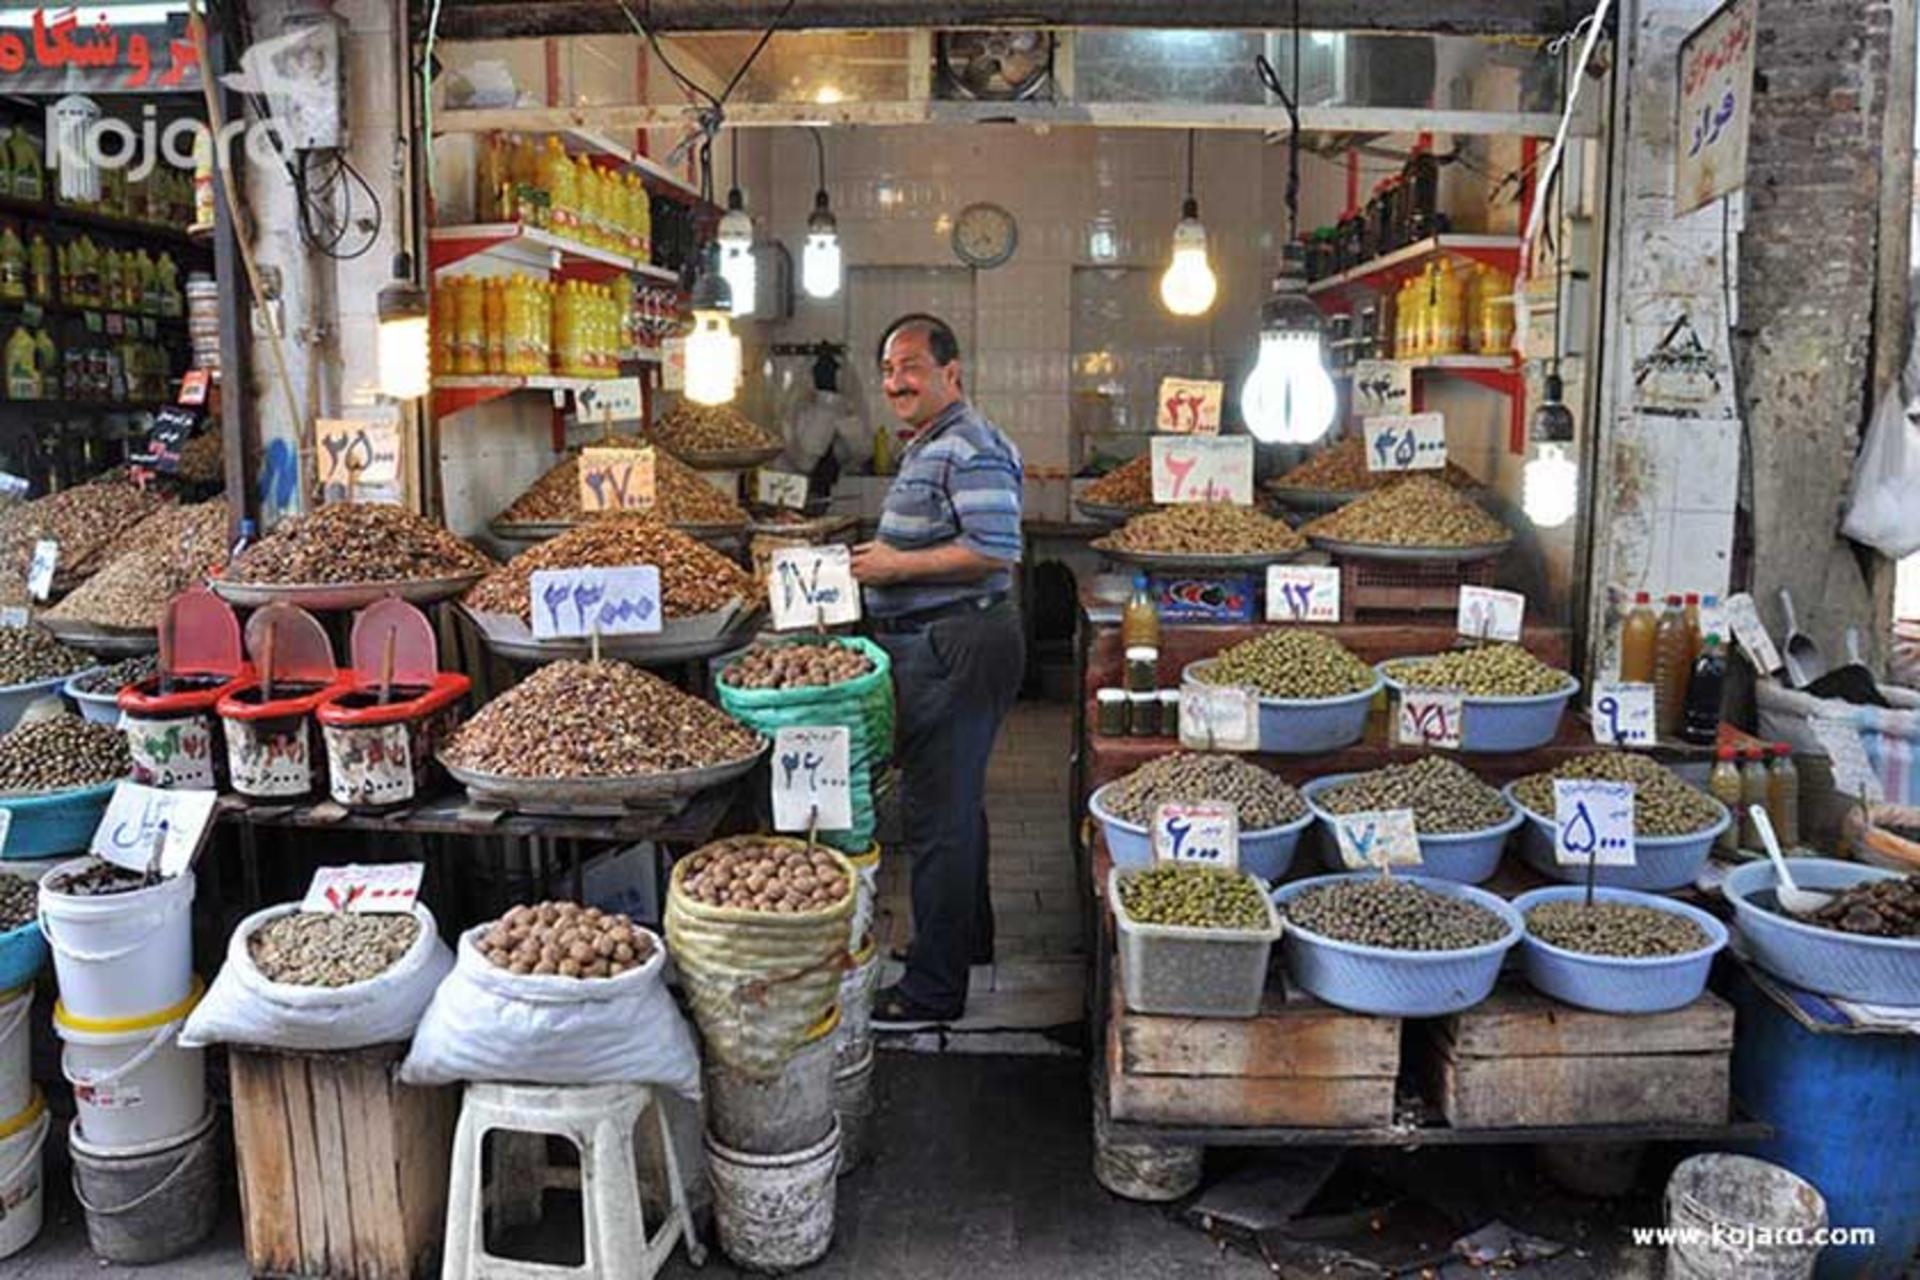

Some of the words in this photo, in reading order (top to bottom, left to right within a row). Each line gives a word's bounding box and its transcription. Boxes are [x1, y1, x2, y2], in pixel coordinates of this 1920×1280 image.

[1374, 427, 1445, 466] ۴۵۰۰۰
[1598, 696, 1647, 740] ۹۰۰۰
[1563, 800, 1627, 853] ۵۰۰۰
